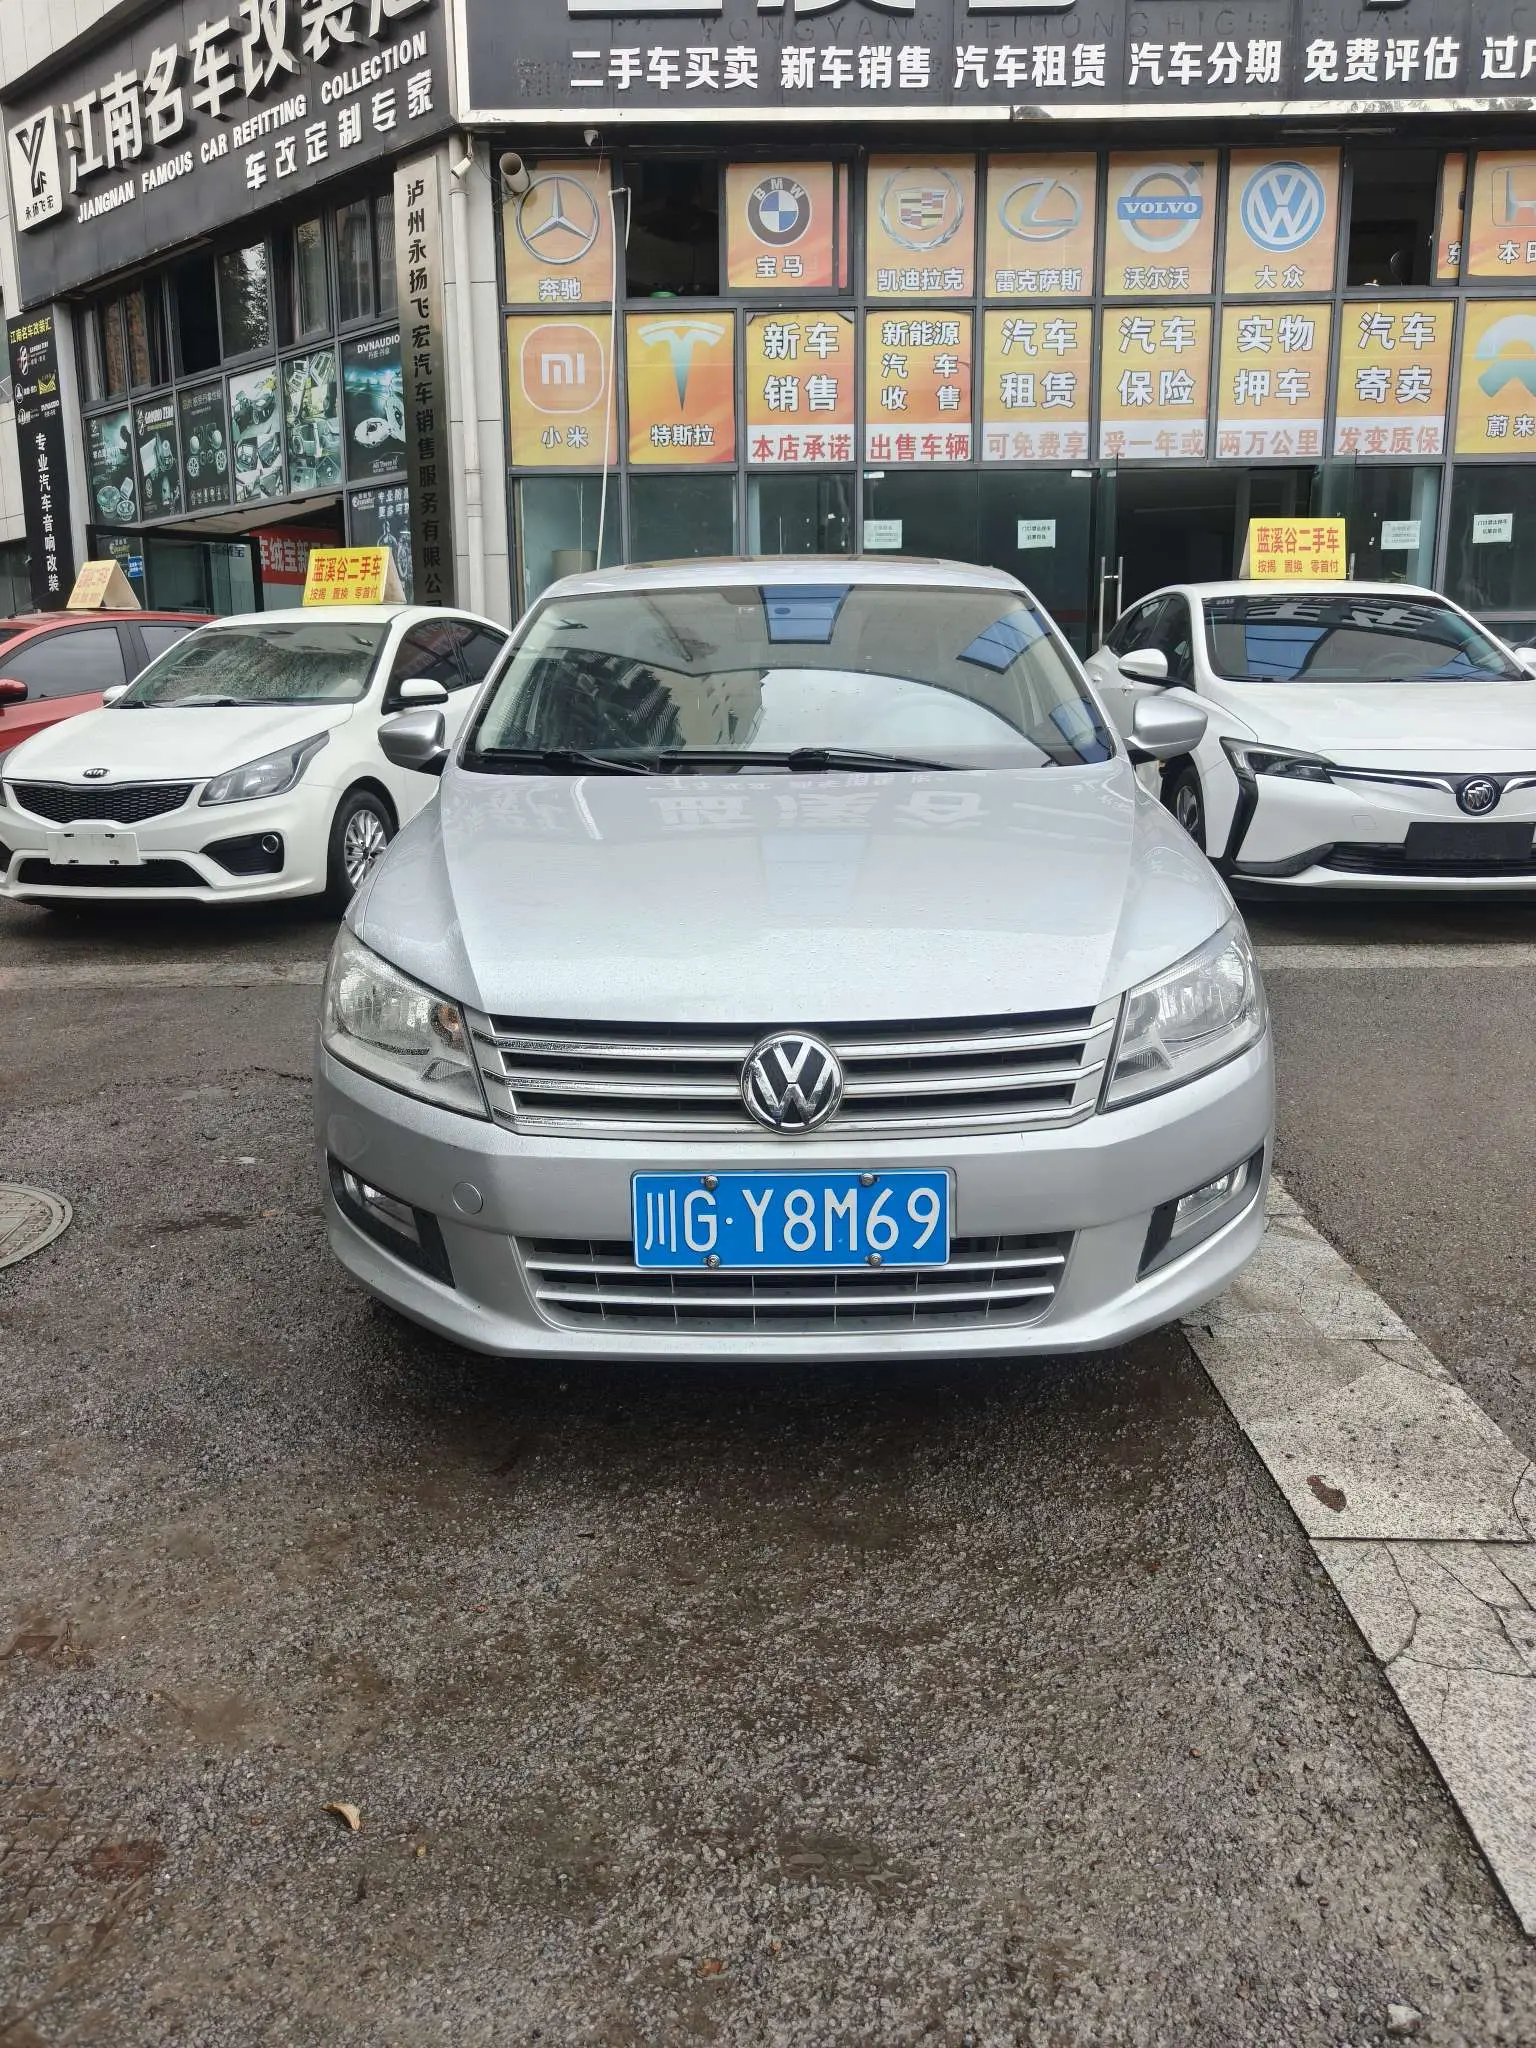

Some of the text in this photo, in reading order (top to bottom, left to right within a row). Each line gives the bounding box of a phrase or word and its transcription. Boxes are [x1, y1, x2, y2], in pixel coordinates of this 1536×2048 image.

[570, 45, 759, 90] 二手车买卖
[780, 45, 931, 89] 新车销售
[954, 43, 1106, 88] 汽车租赁
[1128, 40, 1282, 86] 汽车分期
[1303, 36, 1460, 84] 免费评估
[62, 0, 430, 193] 江南名车改装
[77, 31, 429, 224] JIANGNAN FAMOUS CAR REFITTING COLLECTION
[246, 68, 434, 189] 车改定制专家
[752, 178, 805, 201] BMW
[1123, 202, 1198, 214] VOLVO
[756, 255, 803, 278] 宝马
[877, 268, 964, 291] 凯迪拉克
[995, 269, 1083, 292] 雷克萨斯
[1123, 266, 1189, 290] 沃尔沃
[1255, 264, 1304, 289] 大众
[538, 277, 582, 301] 奔驰
[357, 334, 400, 354] DYNAUDIO
[763, 322, 840, 360] 新车
[881, 321, 961, 347] 新能源
[1001, 318, 1078, 356] 汽车
[1119, 315, 1196, 354] 汽车
[1237, 314, 1315, 353] 实物
[1358, 311, 1437, 350] 汽车
[881, 353, 959, 379] 汽车
[406, 179, 444, 607] 泸州永扬飞宏汽车销售服务有限公
[763, 375, 838, 412] 销售
[881, 385, 961, 411] 收售
[1000, 370, 1078, 409] 租赁
[1117, 369, 1196, 407] 保险
[1233, 367, 1311, 406] 押车
[1355, 364, 1432, 404] 寄卖
[541, 426, 589, 448] 小米
[651, 424, 715, 447] 特斯拉
[1485, 414, 1536, 438] 蔚来
[752, 426, 1440, 462] 本店承诺 出售车辆 可免费享 受一年或 两万公里 发变质保
[35, 432, 61, 592] 专业汽车音响改装
[1256, 527, 1340, 554] 蓝溪谷二手车
[311, 554, 383, 583] 蓝溪谷二手车
[84, 768, 107, 777] KIA
[643, 1186, 942, 1253] 川G·Y8M69
